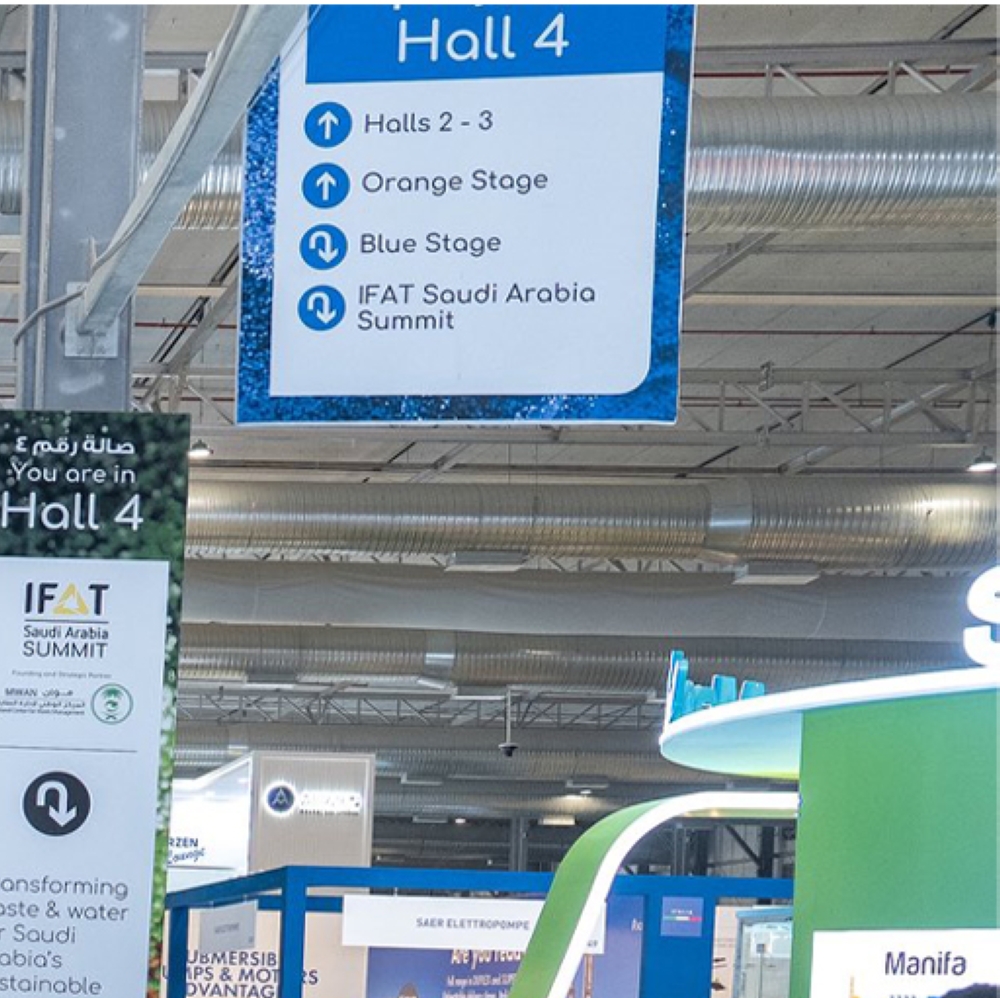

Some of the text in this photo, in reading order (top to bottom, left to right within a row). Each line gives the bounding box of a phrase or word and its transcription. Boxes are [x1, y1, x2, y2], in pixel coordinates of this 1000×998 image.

[398, 12, 570, 63] Hall 4
[364, 113, 431, 133] Halls
[439, 112, 453, 131] 2
[479, 110, 493, 131] 3
[361, 170, 548, 196] Orange Stage
[360, 232, 501, 257] Blue Stage
[358, 282, 596, 305] IFAT Saudi Arabia
[357, 309, 454, 330] Summit
[32, 436, 78, 456] رقم
[82, 434, 136, 455] صالة
[11, 459, 136, 483] You are in
[1, 491, 144, 531] Hall 4
[23, 624, 109, 640] Saudi Arabia
[23, 641, 108, 658] SUMMIT
[168, 837, 199, 847] RZEN
[45, 901, 60, 920] &
[67, 905, 129, 921] water
[13, 924, 76, 943] Saudi
[416, 918, 530, 930] SAER ELETTROPOMPE
[188, 950, 277, 966] UBMERSIB
[885, 951, 966, 976] Manifa
[219, 967, 232, 982] &
[186, 983, 276, 998] DVANTAG
